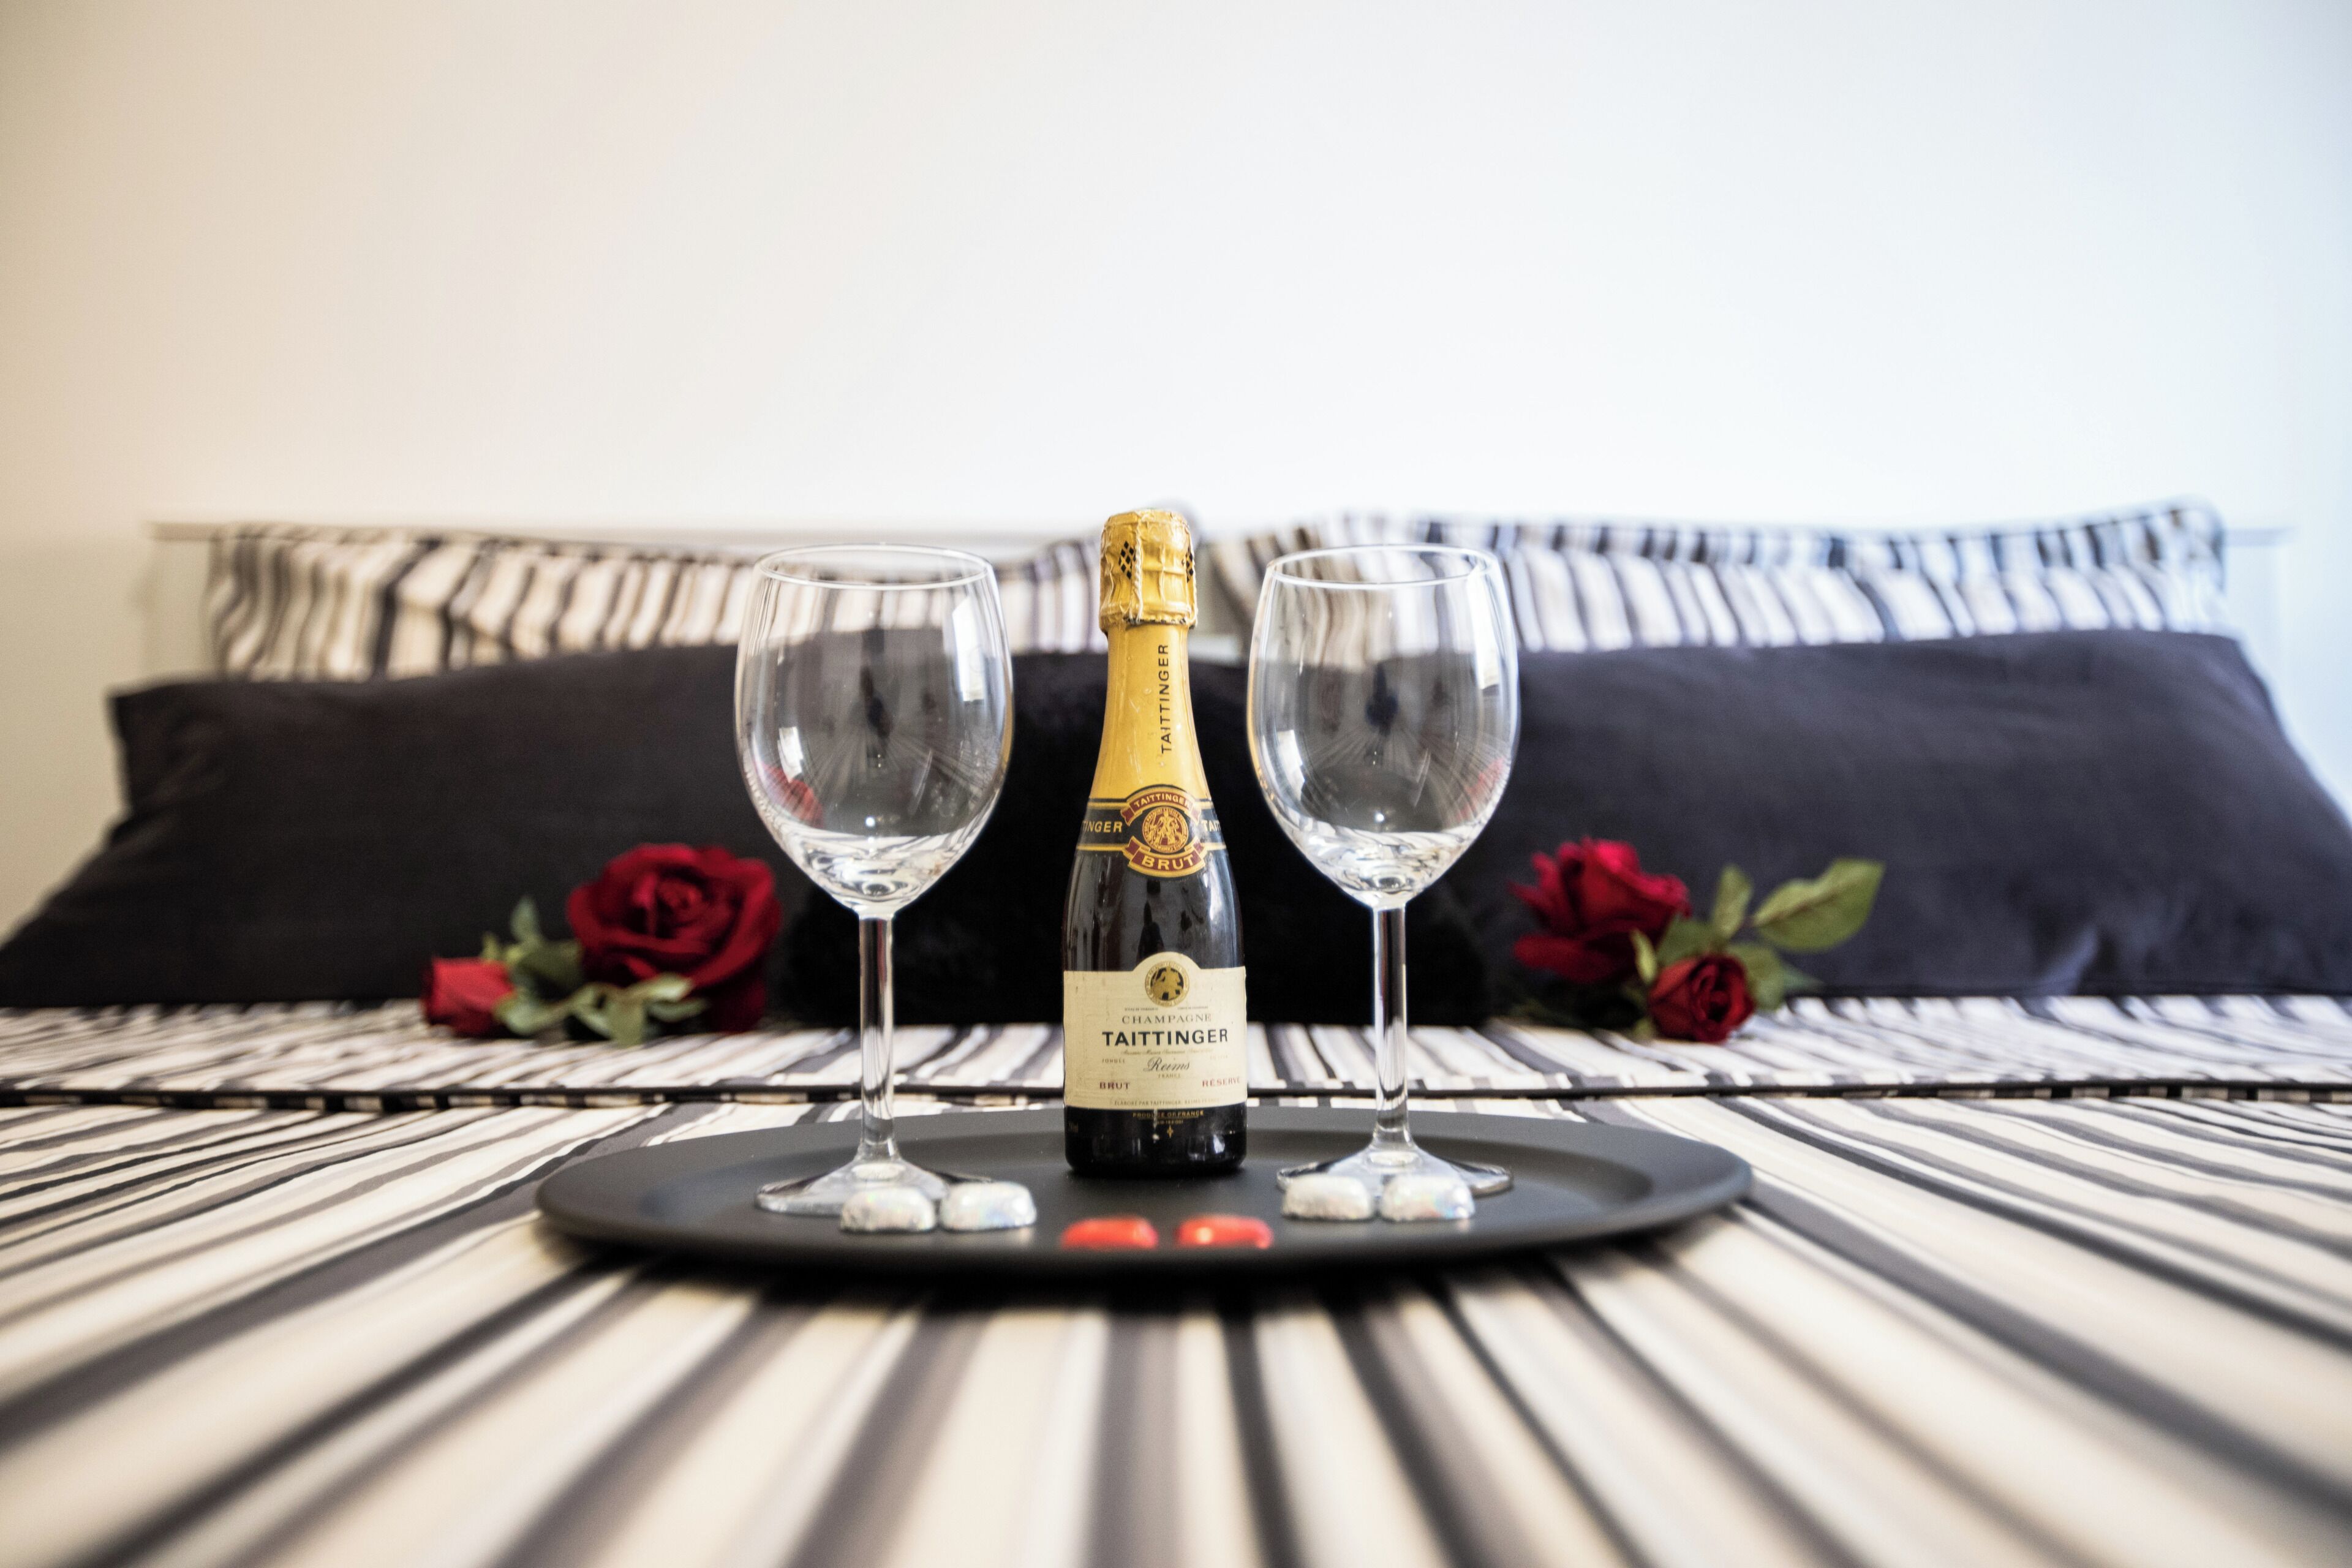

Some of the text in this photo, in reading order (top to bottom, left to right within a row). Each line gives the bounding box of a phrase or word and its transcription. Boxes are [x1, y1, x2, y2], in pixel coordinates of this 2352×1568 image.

[1158, 644, 1172, 754] TAITTINGER
[1134, 793, 1192, 810] TAITTINGER
[1142, 855, 1194, 871] BRUT
[1121, 1014, 1212, 1025] CHAMPAGNE
[1102, 1028, 1228, 1047] TAITTINGER
[1143, 1056, 1191, 1072] Reims
[1099, 1081, 1131, 1090] BRUT
